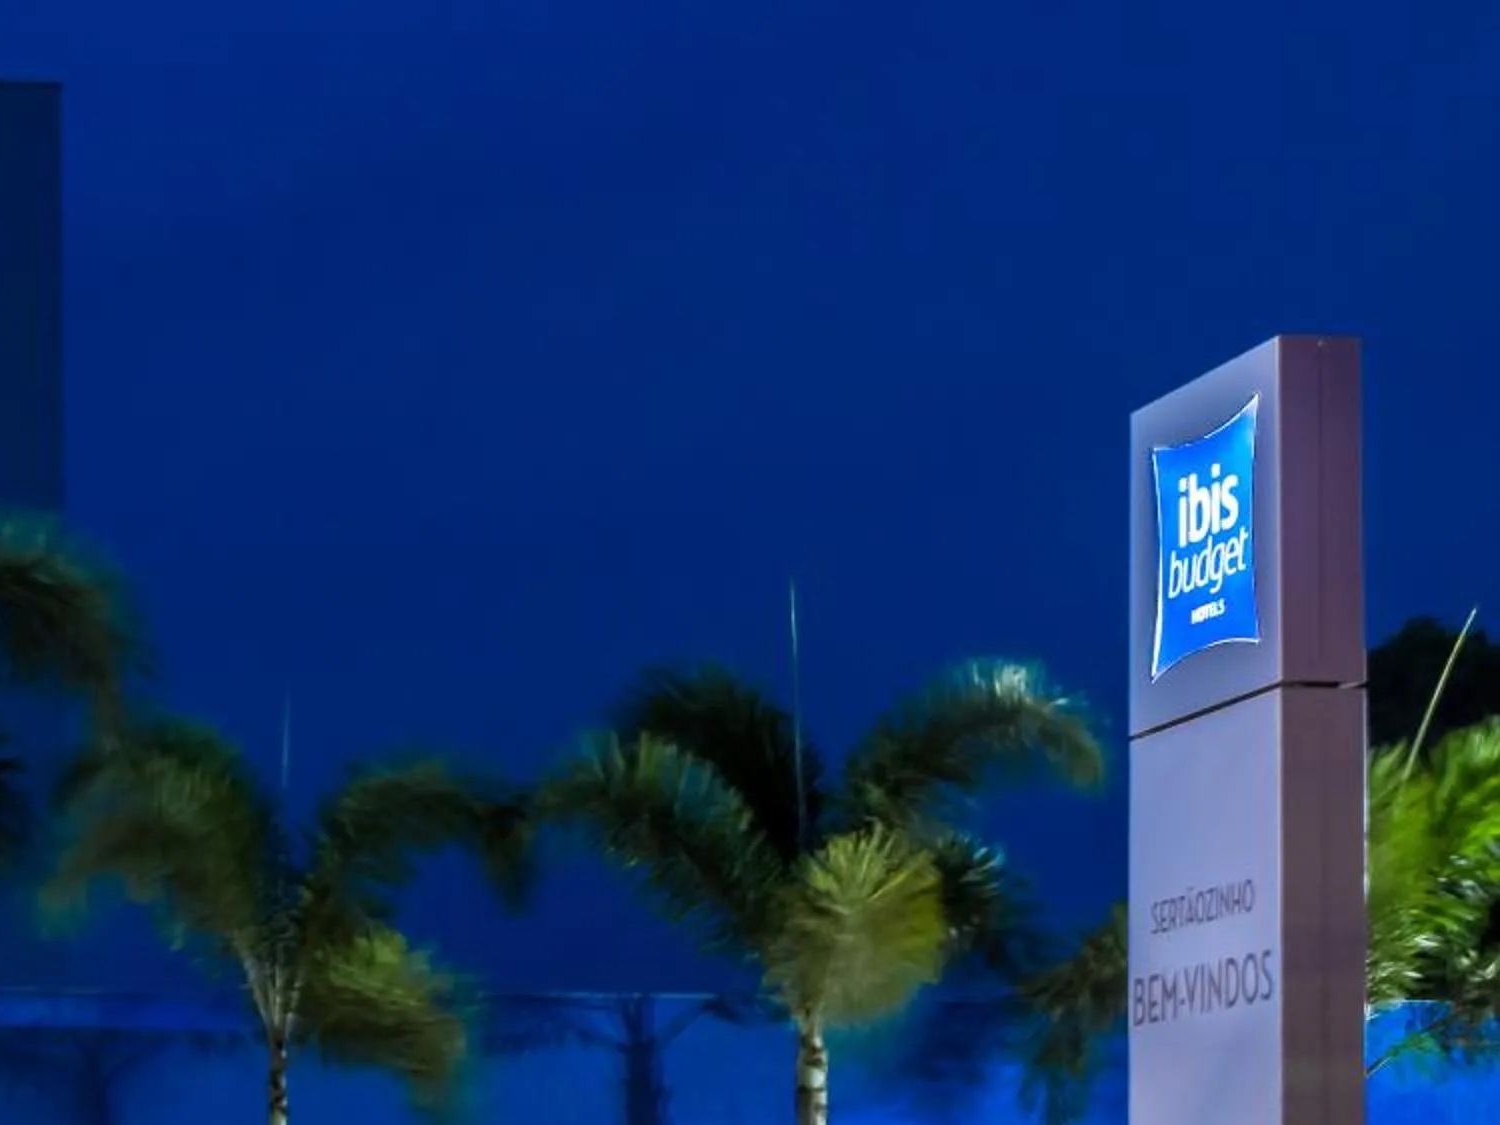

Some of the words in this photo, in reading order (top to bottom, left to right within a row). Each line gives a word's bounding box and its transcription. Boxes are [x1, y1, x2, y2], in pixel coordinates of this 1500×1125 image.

[1177, 463, 1239, 548] ibis
[1168, 525, 1248, 599] budget
[1133, 950, 1274, 1027] BEM-VINDOS
